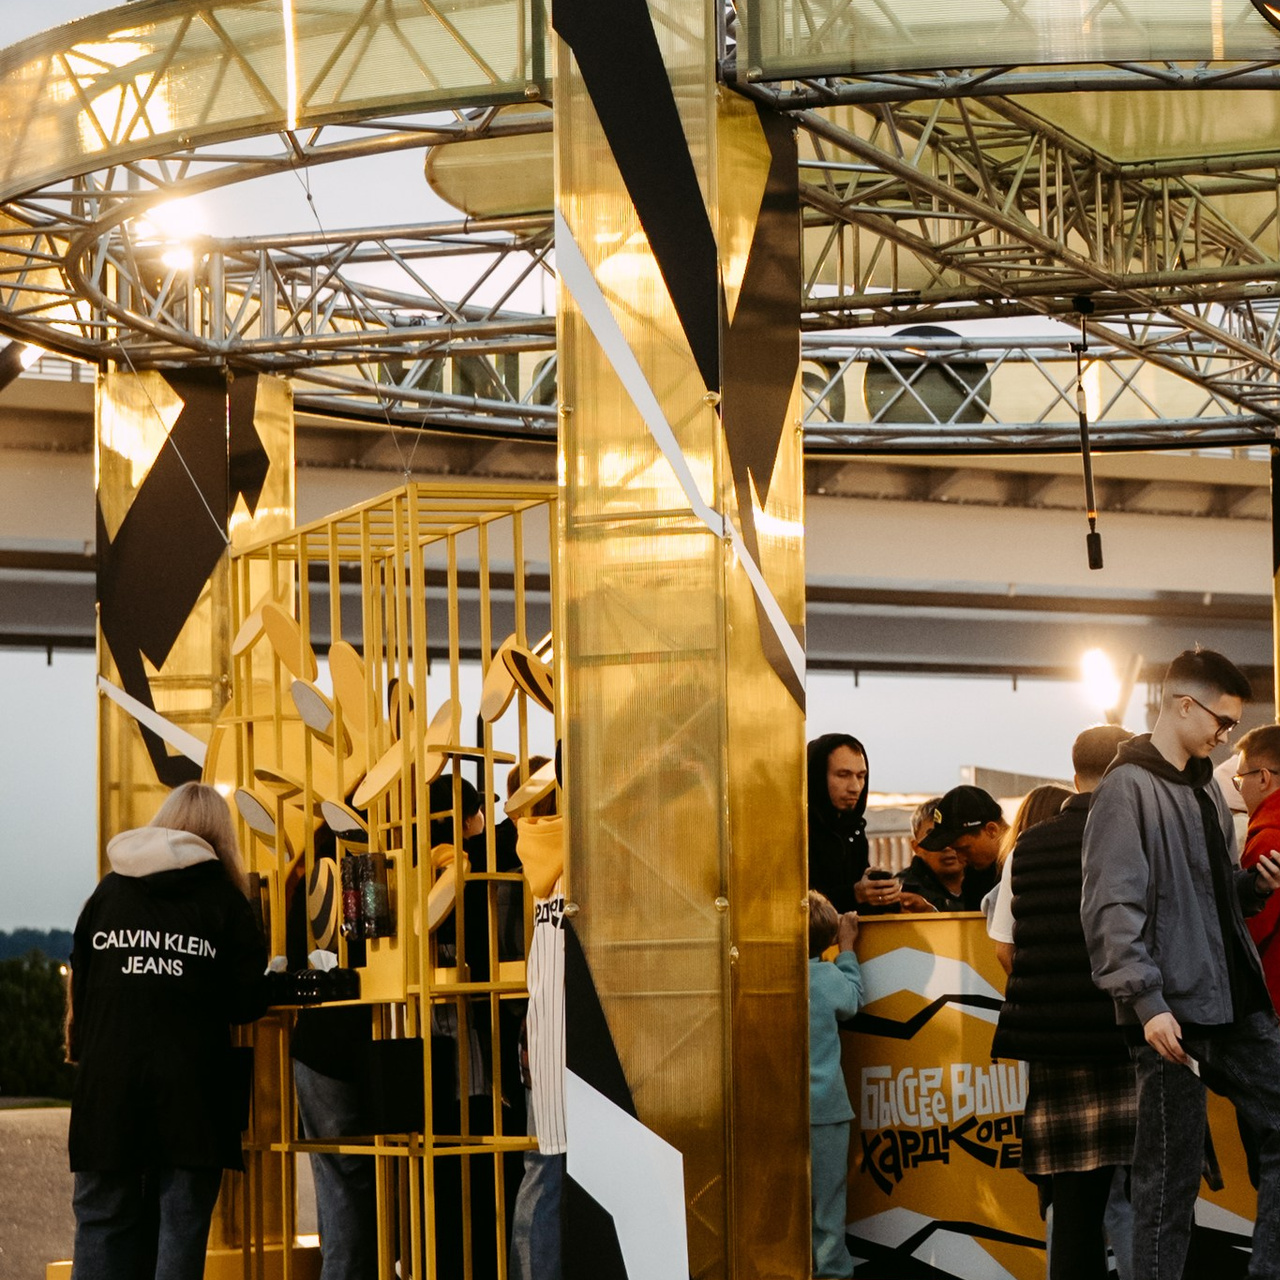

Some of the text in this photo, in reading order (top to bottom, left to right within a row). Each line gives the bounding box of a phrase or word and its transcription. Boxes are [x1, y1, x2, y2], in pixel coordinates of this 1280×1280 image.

[92, 929, 217, 959] CALVIN KLEIN
[121, 956, 184, 977] JEANS
[950, 1059, 1030, 1123] ВЫШ
